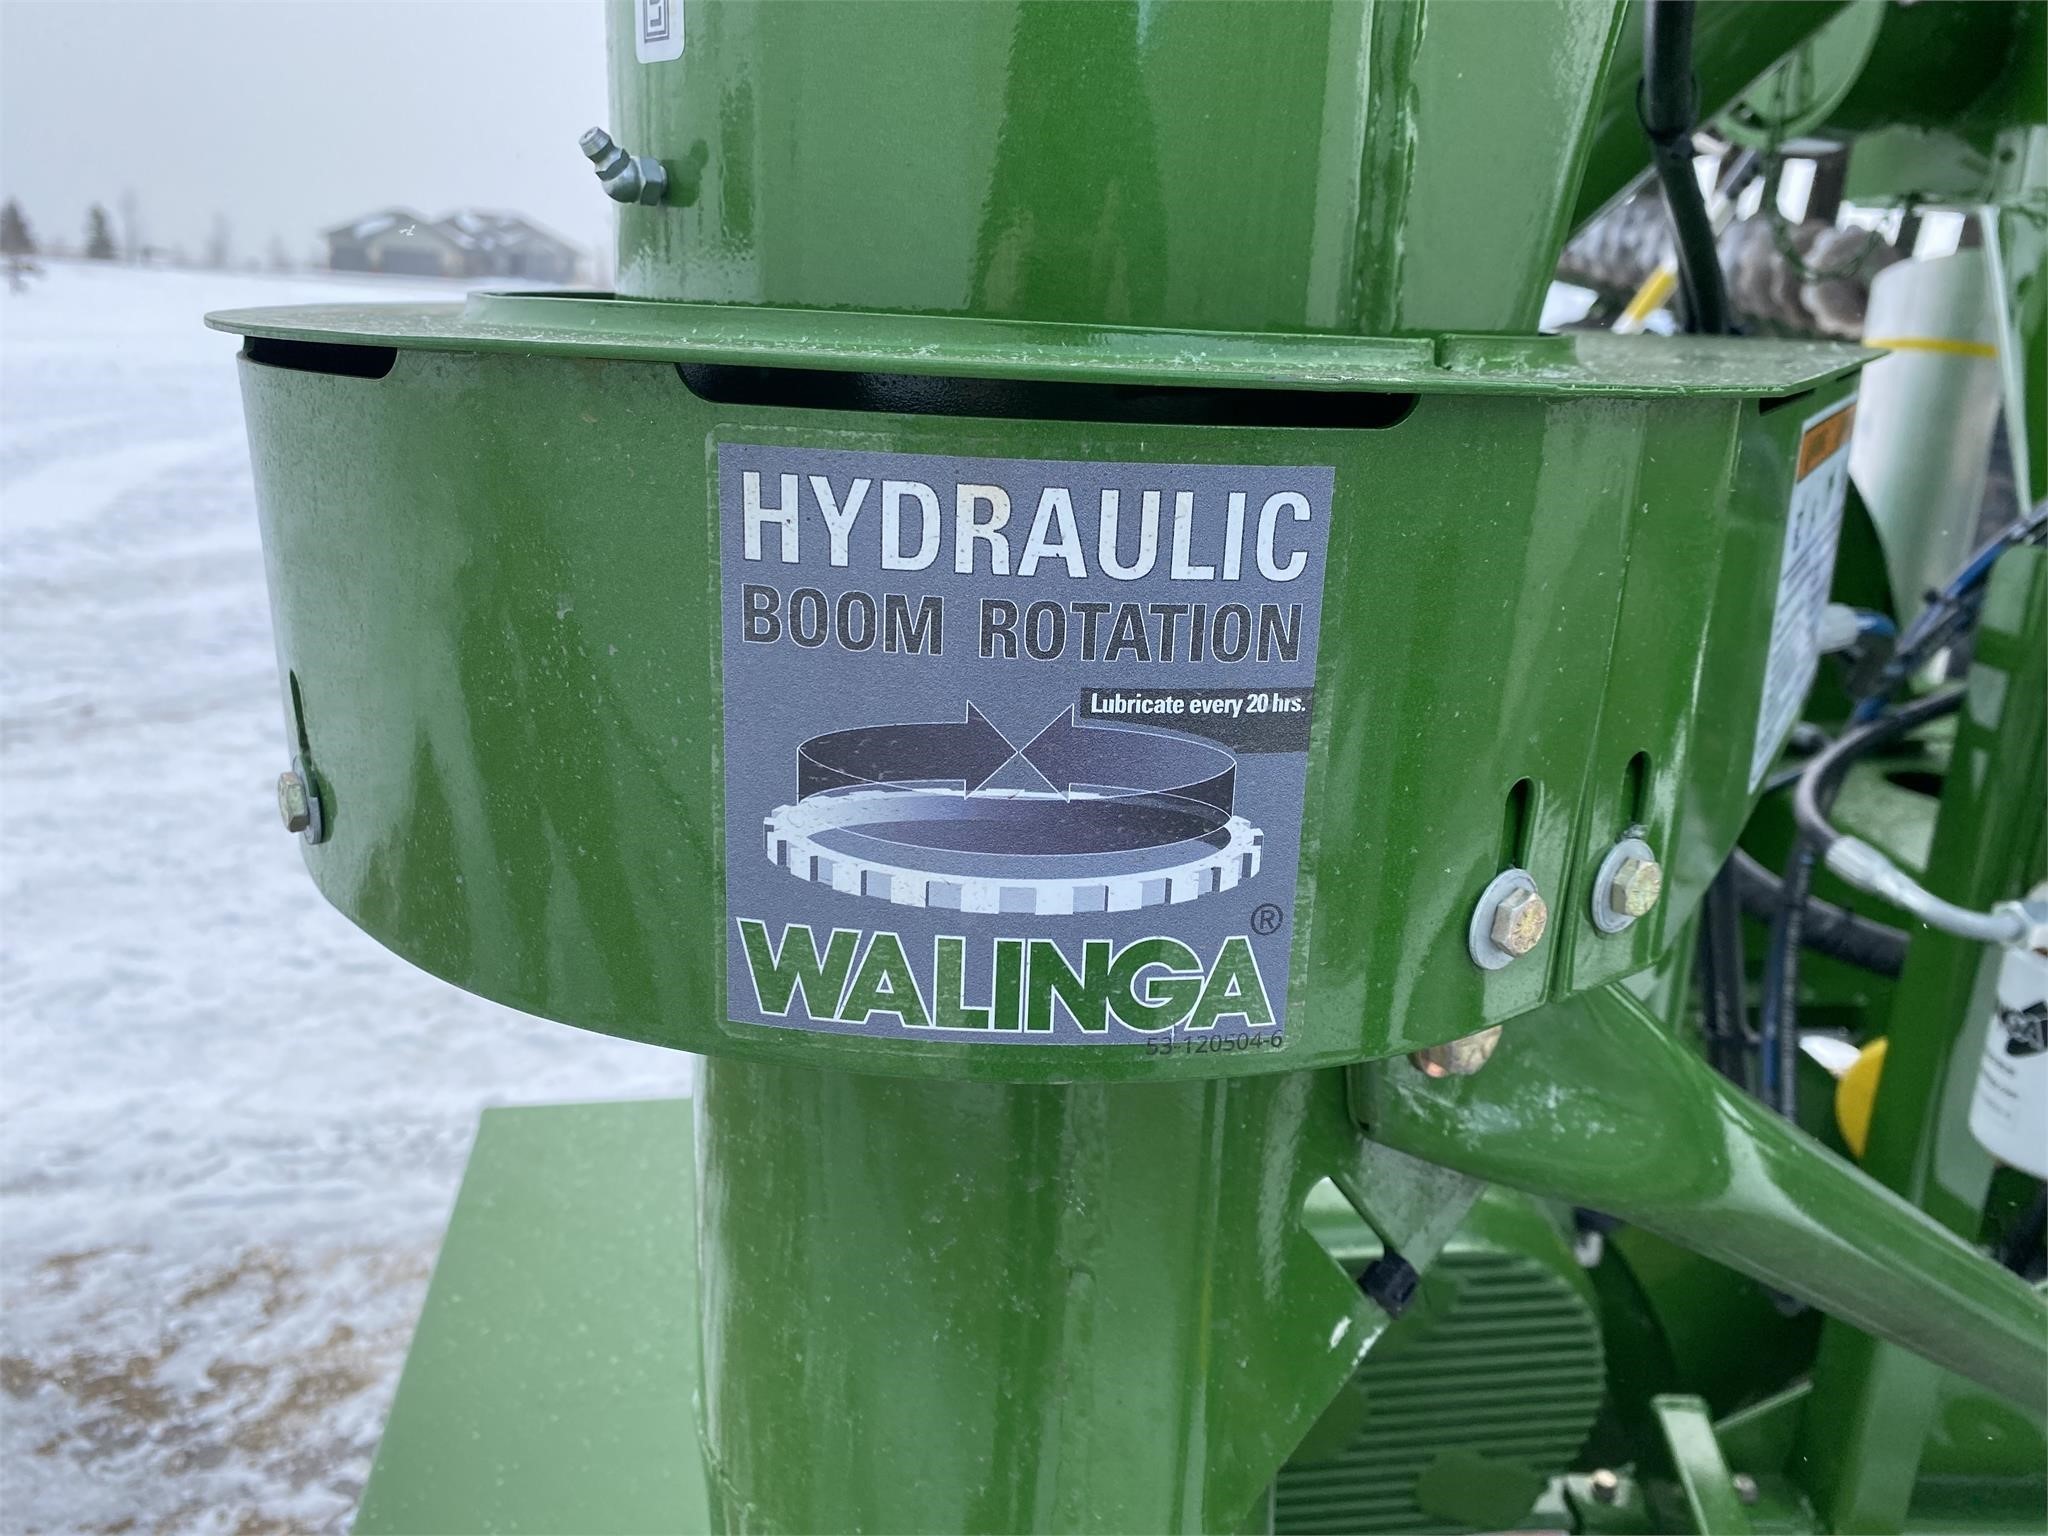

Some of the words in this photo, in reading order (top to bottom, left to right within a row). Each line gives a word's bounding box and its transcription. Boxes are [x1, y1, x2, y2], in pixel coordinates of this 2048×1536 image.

[742, 470, 1312, 582] HYDRAULIC
[742, 583, 944, 656] BOOM
[979, 600, 1304, 663] ROTATION
[1091, 692, 1184, 714] Lubricate
[1189, 697, 1243, 718] every
[1246, 693, 1269, 713] 20
[1271, 692, 1306, 713] hrs.
[736, 917, 1277, 1035] WALINGA
[1145, 1029, 1283, 1056] 53-120504-6
